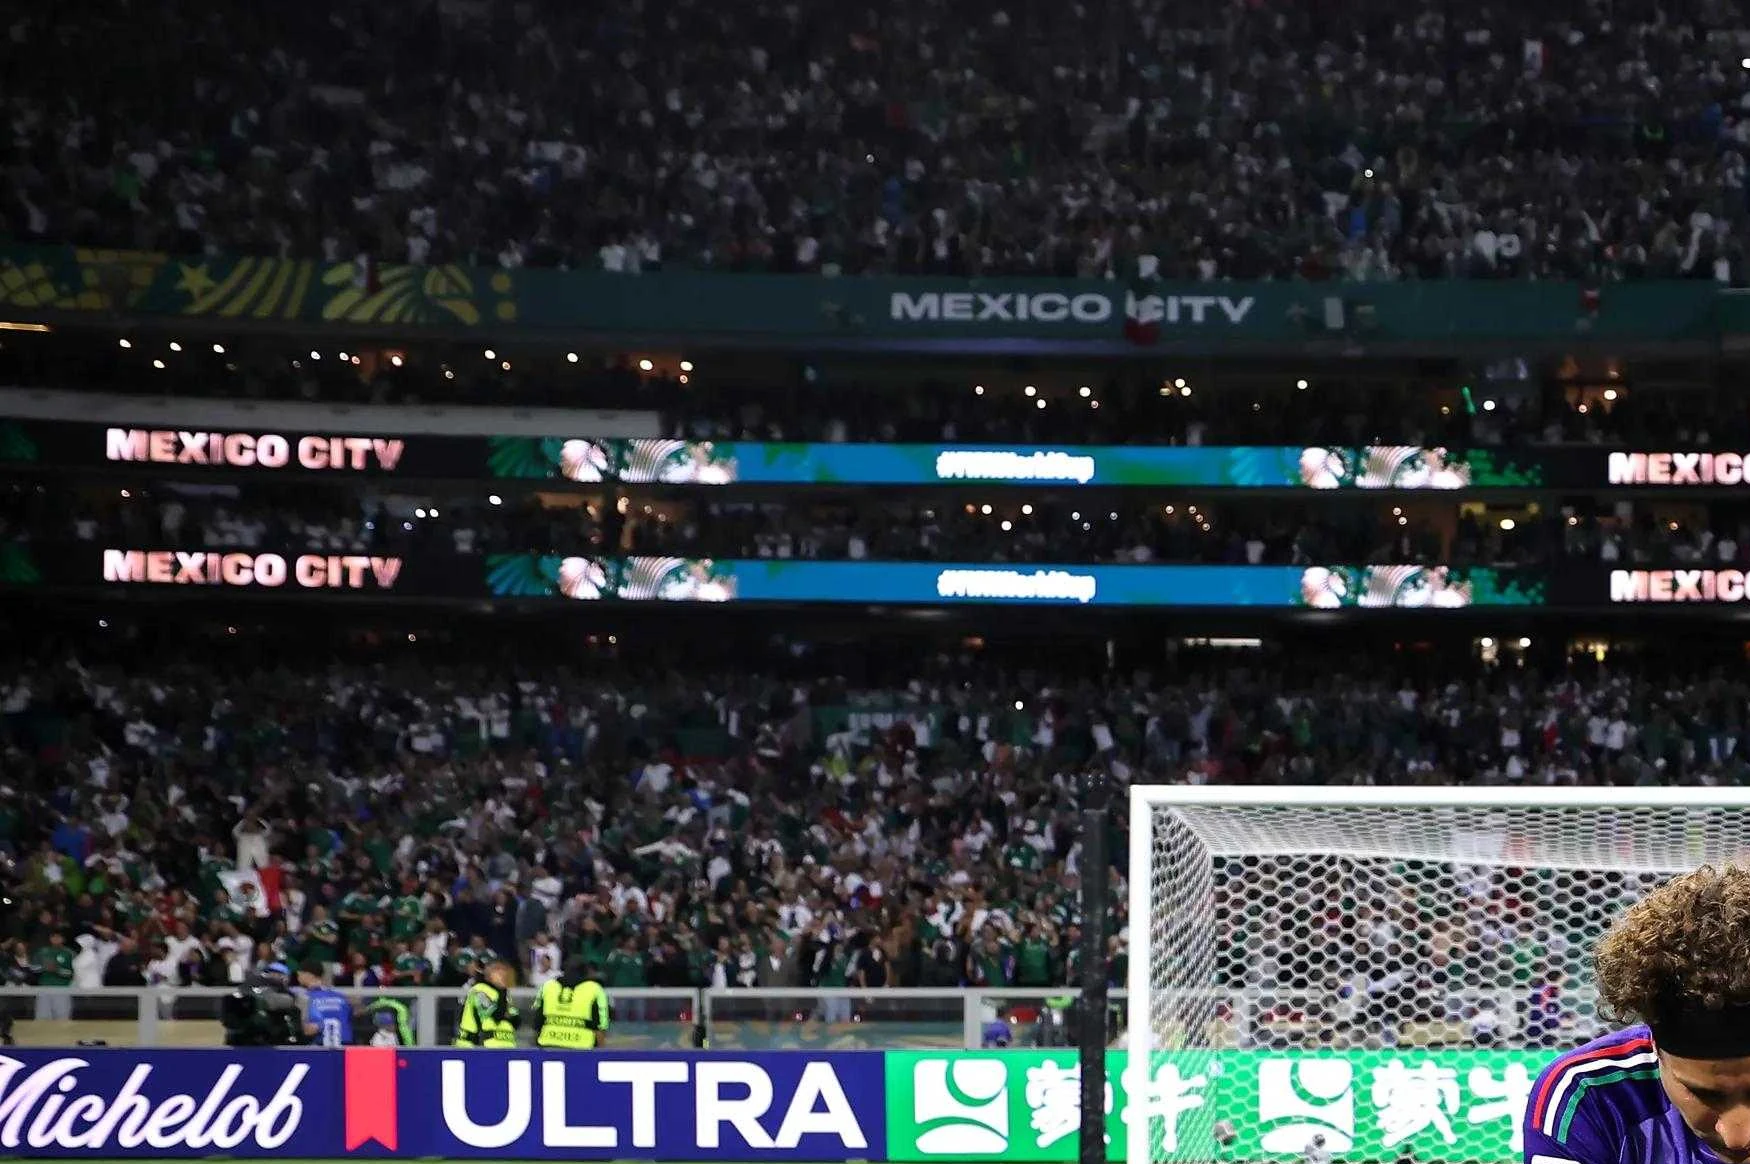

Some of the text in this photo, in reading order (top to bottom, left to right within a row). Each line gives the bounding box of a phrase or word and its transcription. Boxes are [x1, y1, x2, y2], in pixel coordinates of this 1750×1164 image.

[891, 293, 1111, 321] MEXICO
[106, 428, 405, 471] MEXICO CITY
[103, 549, 402, 589] MEXICO CITY
[0, 1054, 868, 1149] Michelob ULTRA
